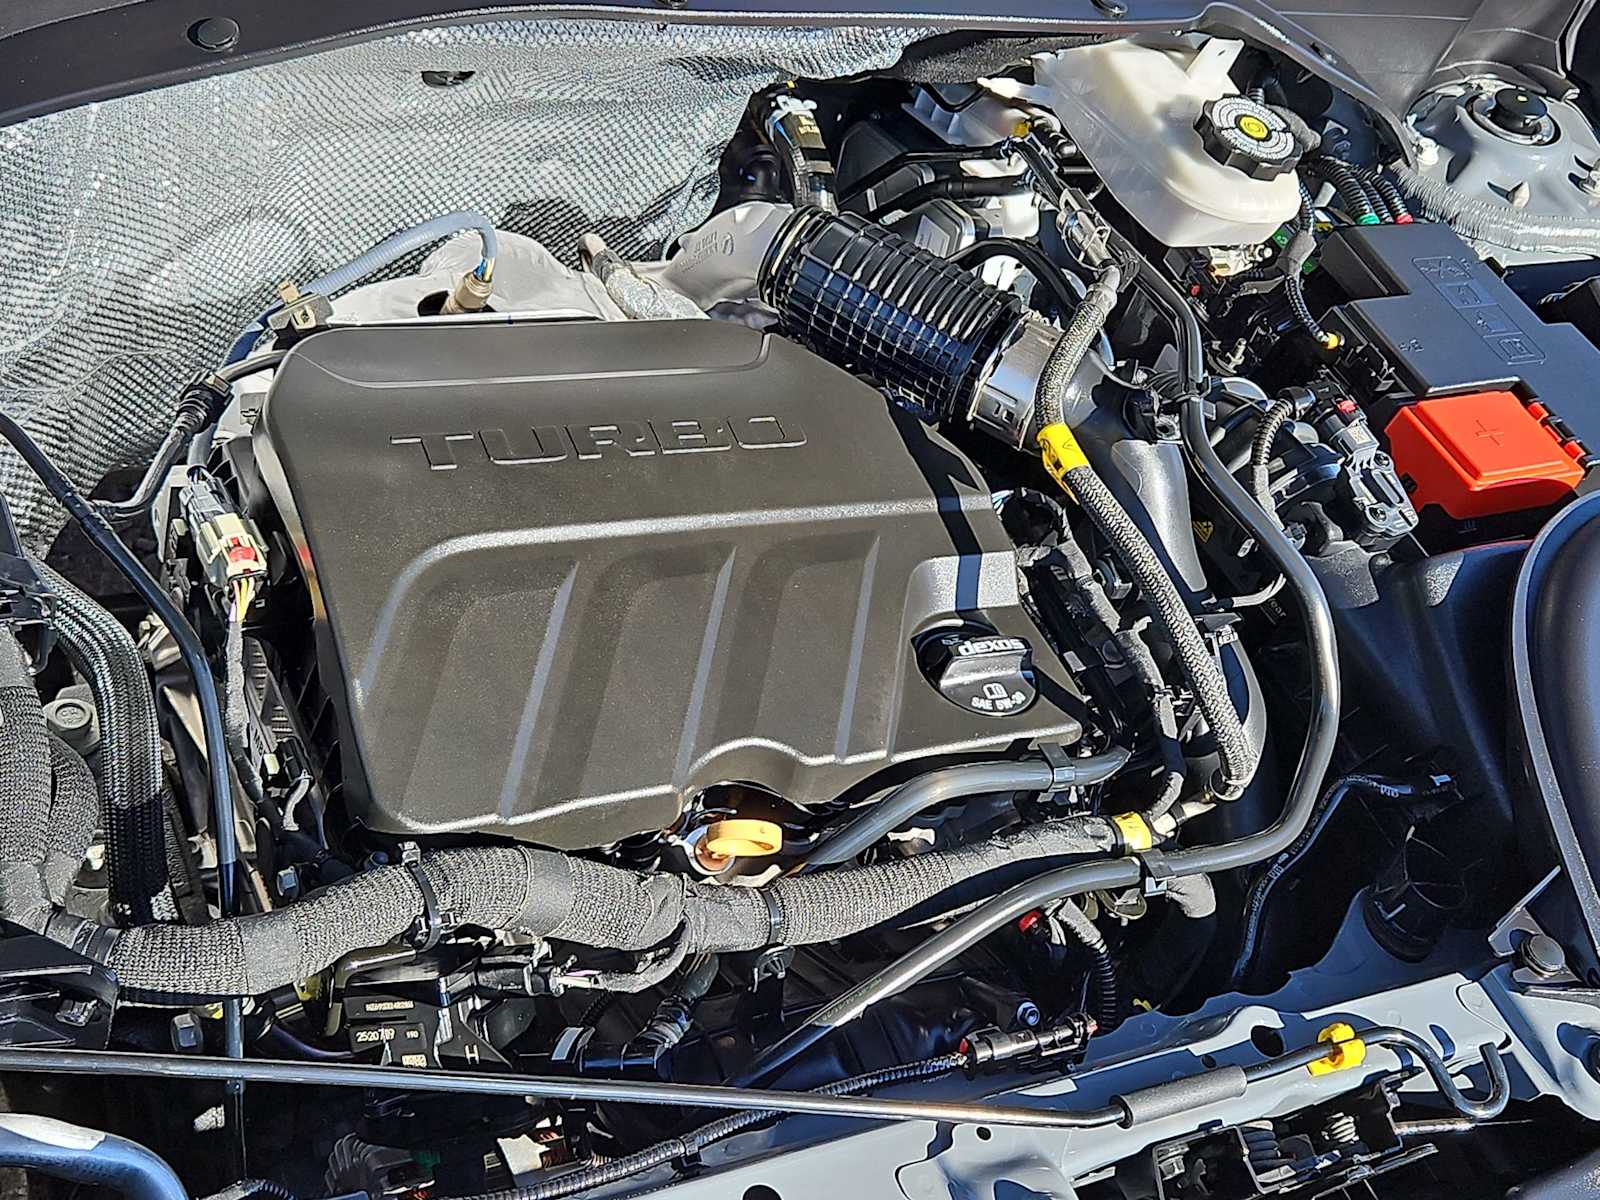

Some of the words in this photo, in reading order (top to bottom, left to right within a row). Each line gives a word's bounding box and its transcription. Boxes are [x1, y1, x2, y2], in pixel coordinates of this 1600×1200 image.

[389, 415, 807, 471] TURBO
[958, 638, 1025, 656] dexos
[970, 696, 994, 710] SAE
[464, 1044, 479, 1065] H
